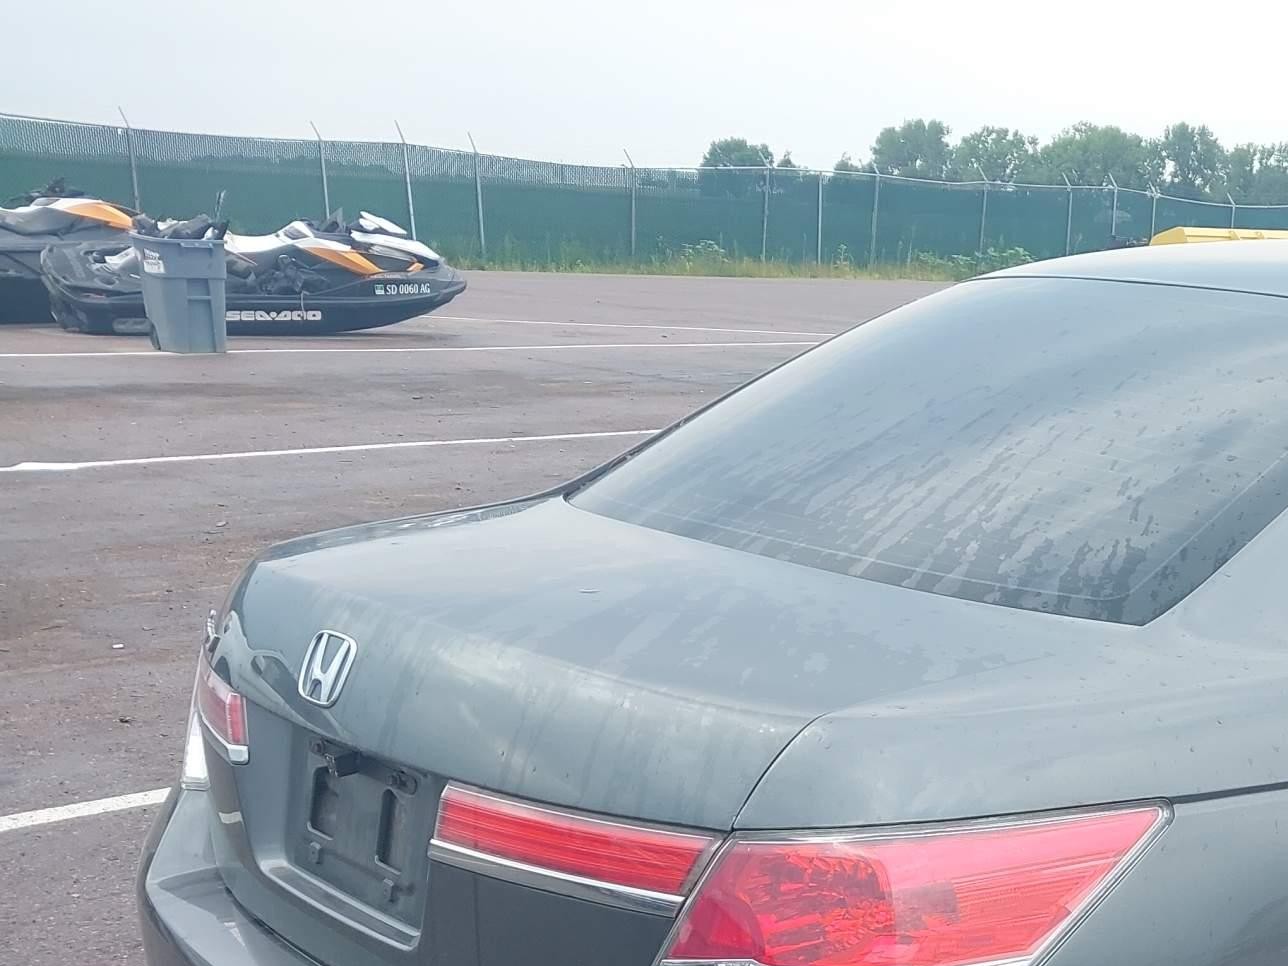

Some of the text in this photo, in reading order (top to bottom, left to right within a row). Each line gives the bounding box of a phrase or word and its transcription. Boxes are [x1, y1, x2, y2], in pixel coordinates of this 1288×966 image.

[386, 283, 431, 295] SD 0060 AG
